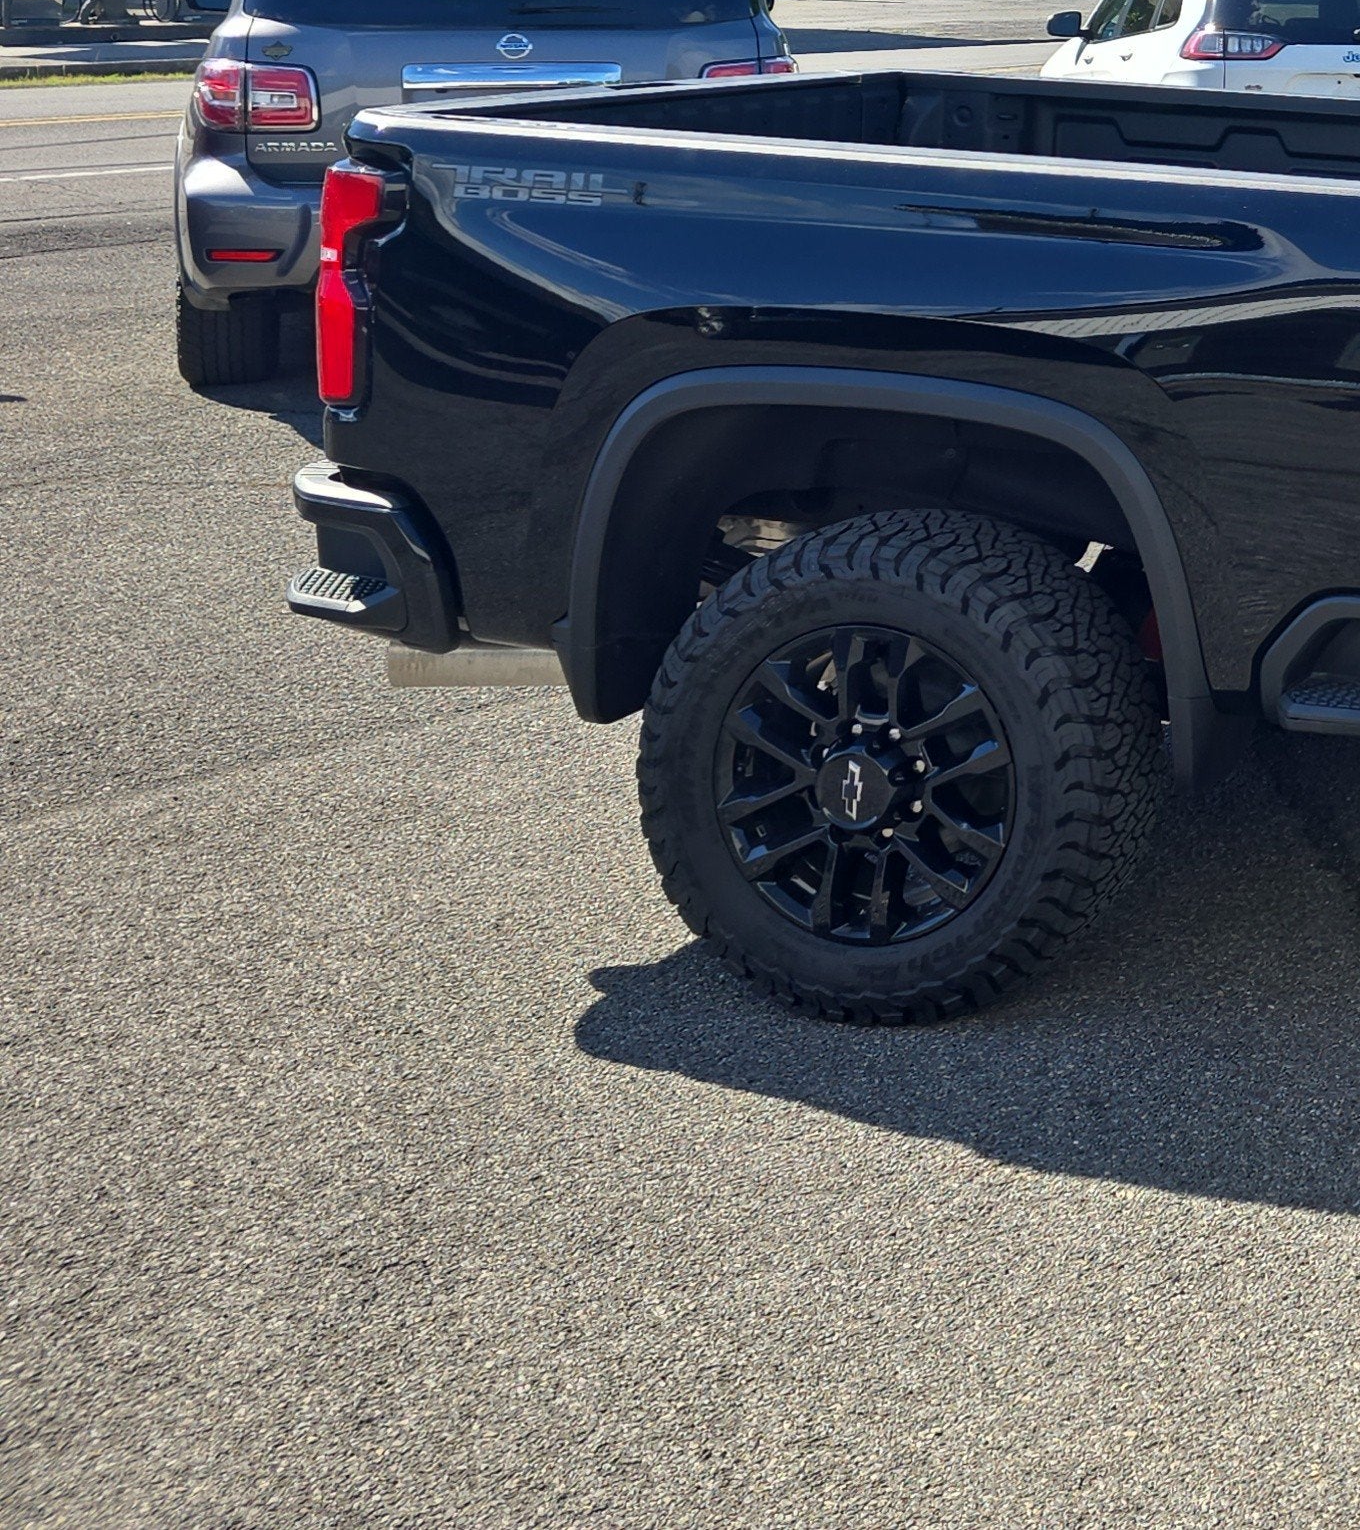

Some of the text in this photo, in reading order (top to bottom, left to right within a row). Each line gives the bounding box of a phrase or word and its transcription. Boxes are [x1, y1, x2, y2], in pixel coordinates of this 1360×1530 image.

[255, 142, 338, 152] ARMADA
[432, 164, 629, 194] TRAIL
[453, 183, 603, 207] BOSS
